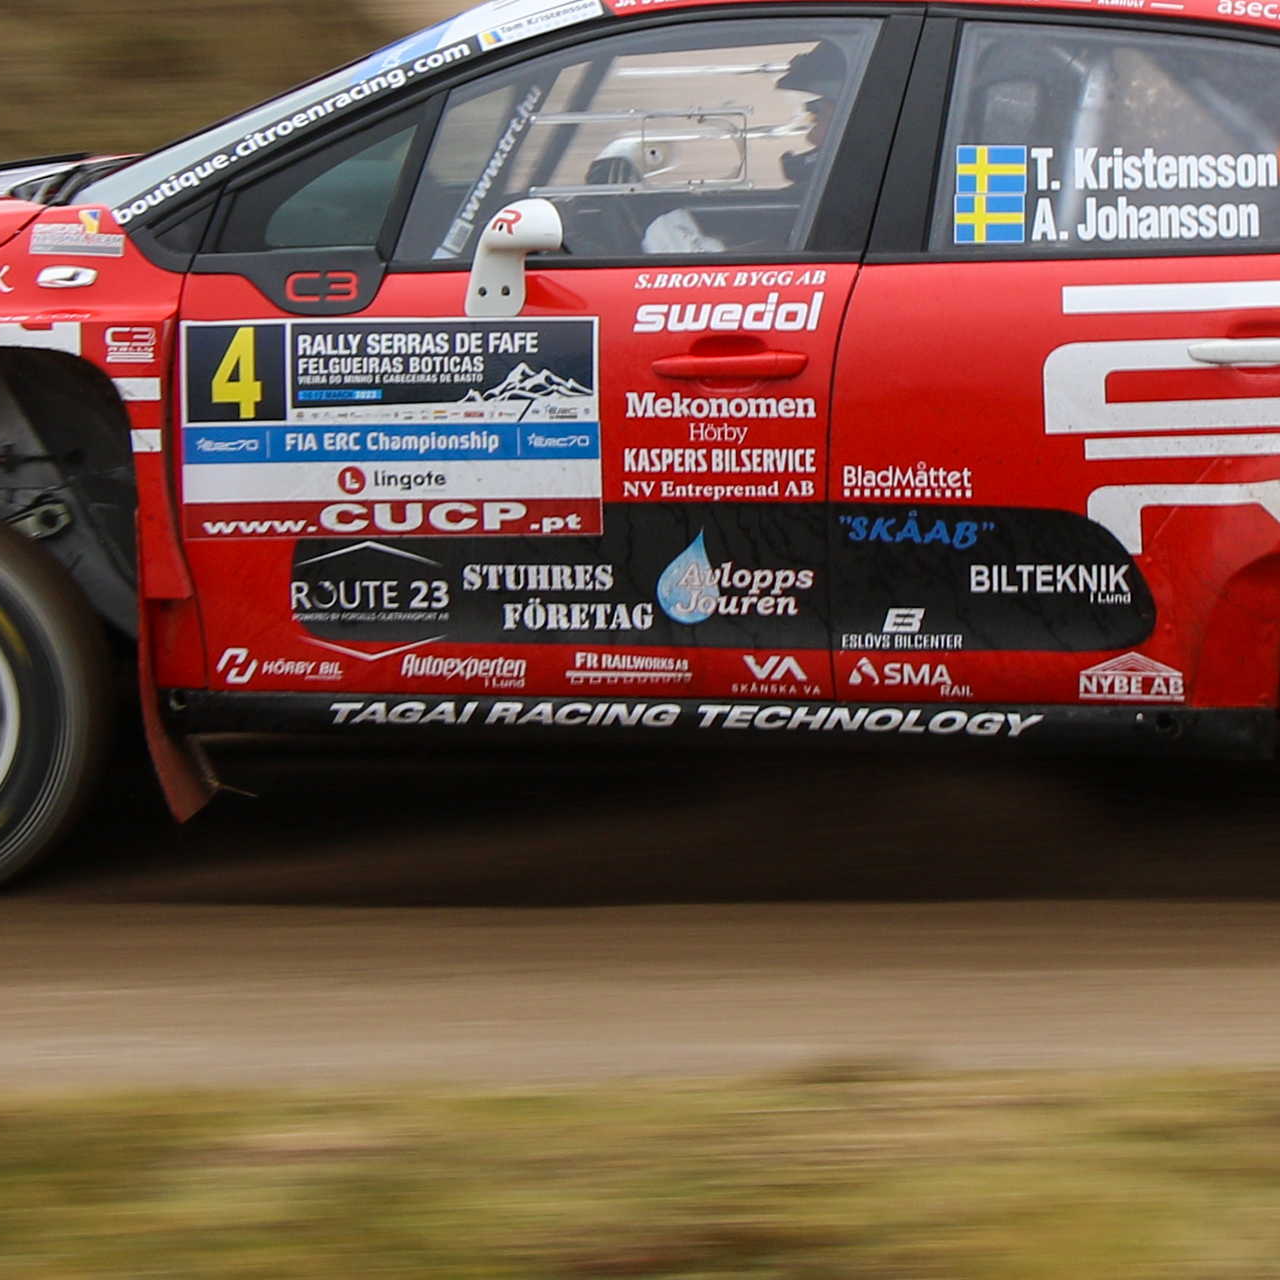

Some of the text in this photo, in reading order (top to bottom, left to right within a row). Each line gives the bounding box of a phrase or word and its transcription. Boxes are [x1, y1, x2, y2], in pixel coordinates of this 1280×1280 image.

[501, 1, 597, 34] Tom Kristensson
[113, 42, 472, 226] boutique.citroenracing.com
[1031, 146, 1279, 190] T. Kristensson
[1031, 197, 1260, 241] A. Johansson
[285, 271, 359, 302] C3
[634, 269, 827, 290] S.BRONK BYGG AB
[632, 291, 825, 333] swedol
[105, 326, 157, 347] C3
[298, 331, 539, 356] RALLY SERRAS DE FAFE
[211, 326, 263, 420] 4
[298, 355, 485, 375] FELGUEIRAS BOTICAS
[625, 392, 817, 419] Mekonomen
[285, 429, 500, 454] FIA ERC Championship
[688, 423, 749, 445] Hörby
[623, 448, 816, 473] KASPERS BILSERVICE
[843, 461, 973, 490] BladMåttet
[622, 480, 815, 501] NV Entreprenad AB
[203, 501, 583, 534] www.CUCP.pt
[461, 563, 615, 592] STUHRES
[676, 561, 815, 595] Avlopps
[970, 564, 1131, 594] BILTEKNIK
[290, 579, 451, 610] ROUTE 23
[672, 587, 799, 617] Jouren
[1097, 592, 1131, 605] Lund
[503, 598, 655, 630] FÖRETAG
[841, 632, 963, 650] ESLÖVS BILCENTER
[261, 658, 344, 675] HÖRBY BIL
[400, 654, 527, 681] Autoexperten
[575, 651, 689, 671] FR RAILWORKS AB
[883, 662, 953, 686] SMA
[491, 678, 526, 689] Lund
[731, 681, 822, 695] SKÅNSKA VA
[940, 684, 973, 697] RAIL
[1079, 675, 1185, 696] NYBE AB
[328, 701, 1045, 737] TAGAI RACING TECHNOLOGY
